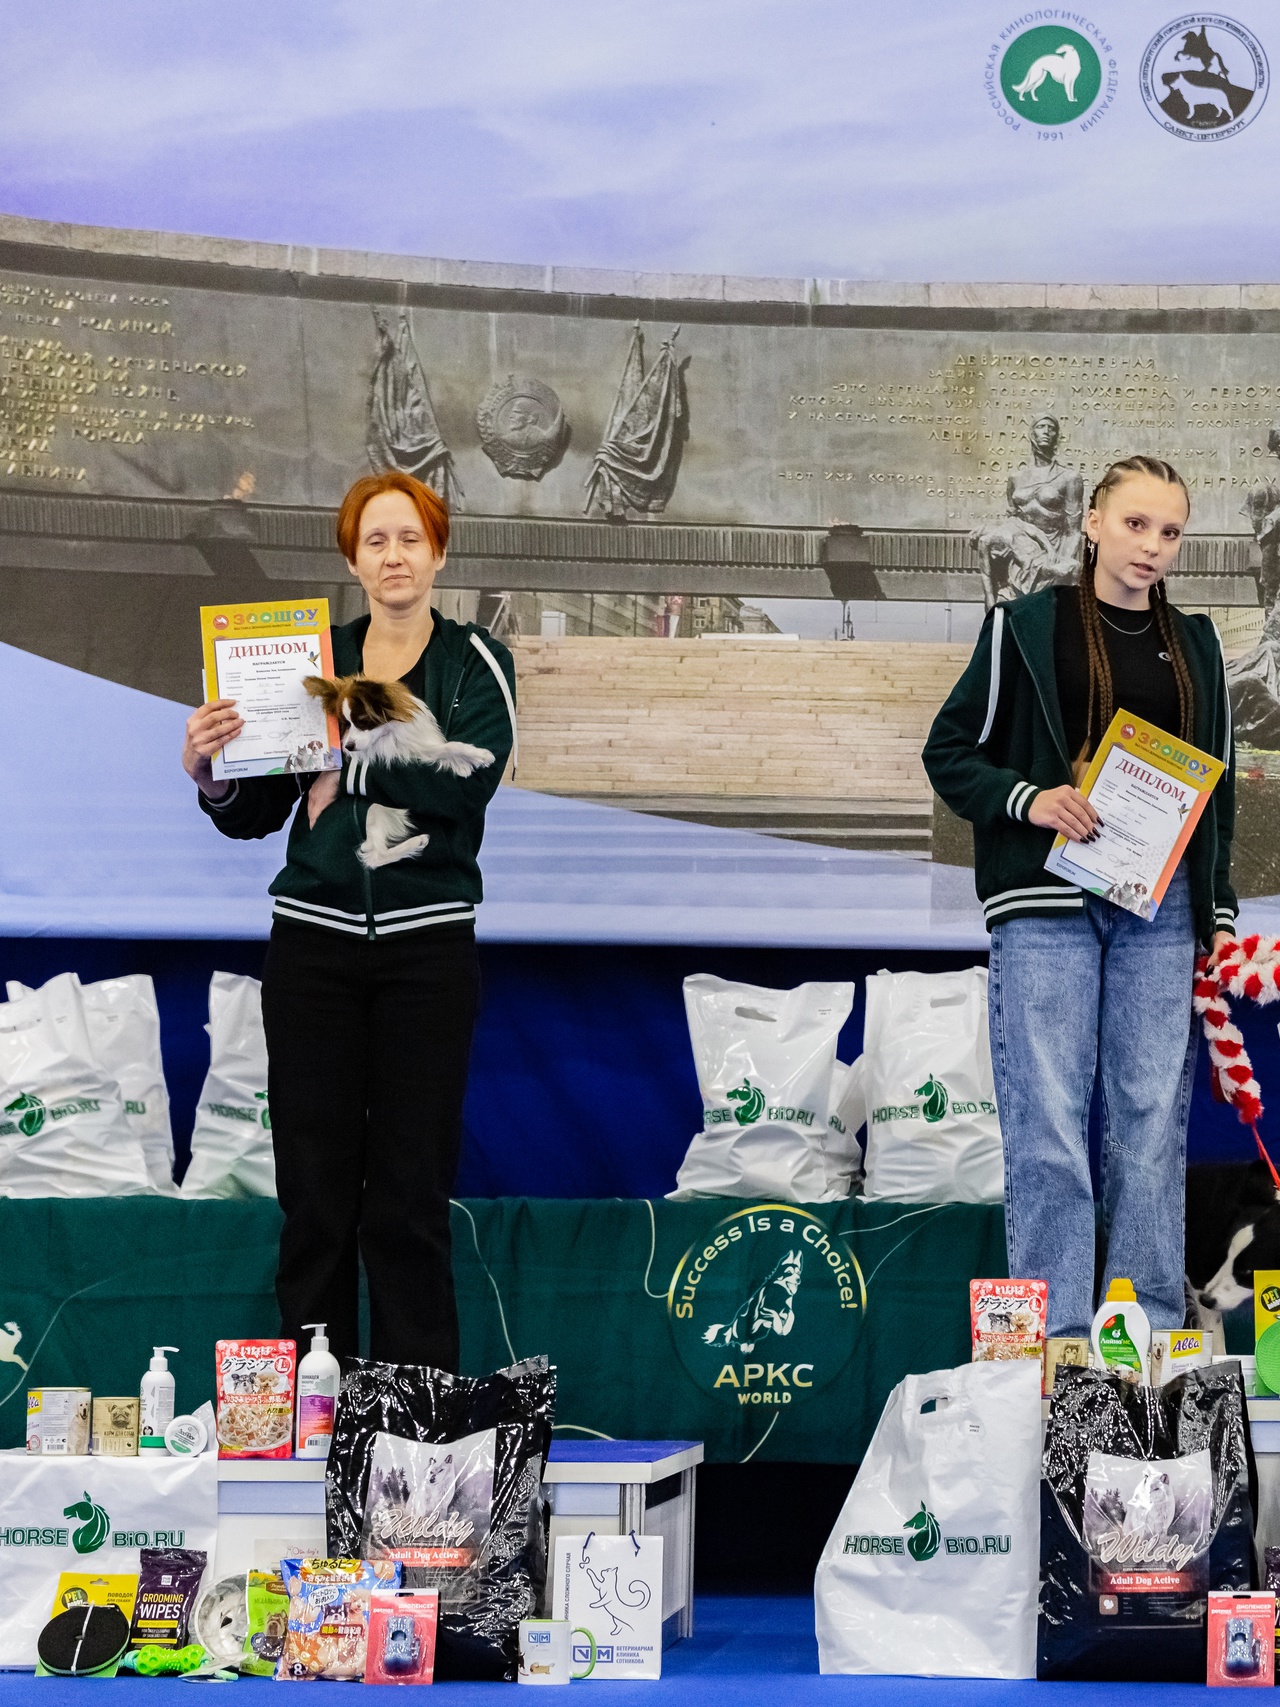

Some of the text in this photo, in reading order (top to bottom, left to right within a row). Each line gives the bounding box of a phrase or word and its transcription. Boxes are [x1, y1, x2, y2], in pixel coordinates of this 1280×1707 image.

[984, 8, 1120, 134] РОССИЙСКАЯ КИНОЛОГИЧЕСКАЯ ФЕДЕРАЦИЯ
[1036, 130, 1064, 142] 1991
[954, 354, 1156, 370] ДЕВЯТИСОТДНЕВНАЯ
[928, 369, 1181, 383] ЗАЩИТА ОСАЖДЕННОГО ГОРОДА
[1071, 386, 1172, 399] МУЖЕСТВА
[233, 608, 318, 629] ЗООШОУ
[228, 641, 309, 660] ДИПЛОМ
[1137, 731, 1213, 776] ЗООШОУ
[1115, 757, 1187, 803] ДИПЛОМ
[208, 1103, 258, 1122] HORSE
[871, 1104, 921, 1125] HORSE
[675, 1215, 859, 1319] Success Is a Choice!
[1263, 1289, 1280, 1304] PET
[713, 1363, 815, 1389] APKC
[737, 1391, 793, 1405] WORLD
[842, 1534, 1012, 1557] HORSE BiO.RU
[389, 1550, 460, 1561] Adult Dog Active
[1110, 1575, 1180, 1586] Adult Dog Active
[143, 1593, 184, 1603] GROOMING
[140, 1604, 181, 1619] WIPES
